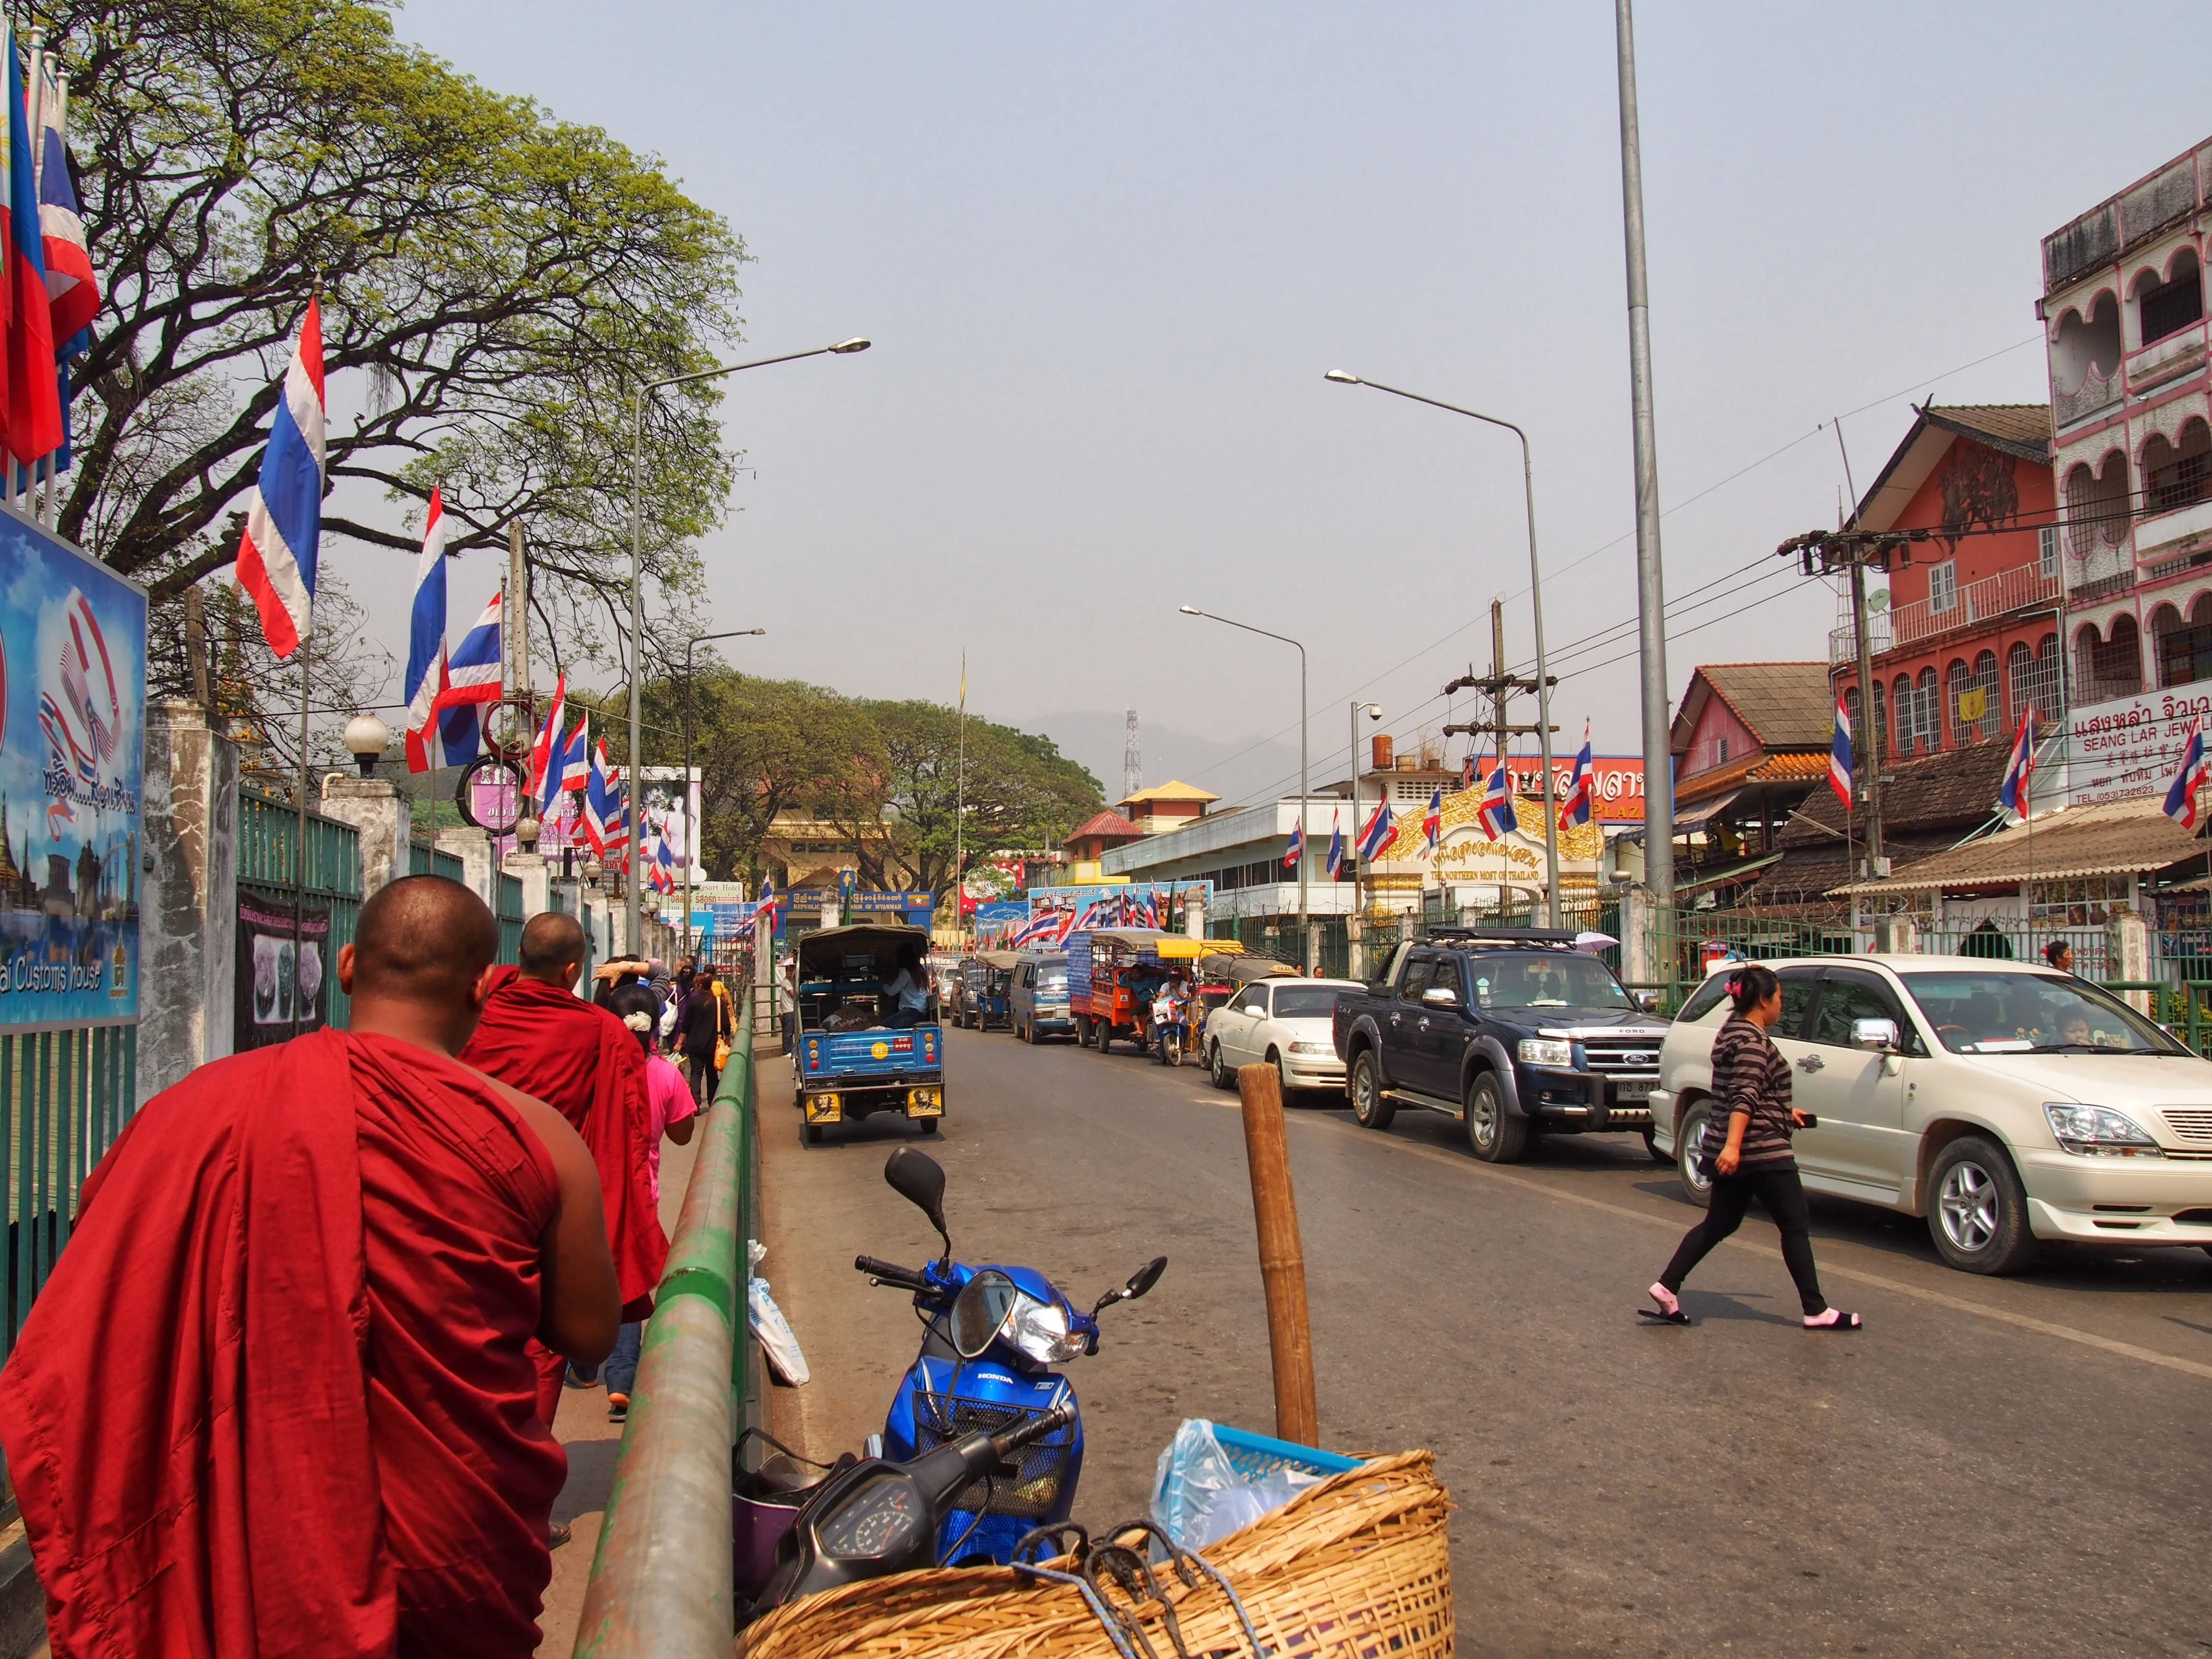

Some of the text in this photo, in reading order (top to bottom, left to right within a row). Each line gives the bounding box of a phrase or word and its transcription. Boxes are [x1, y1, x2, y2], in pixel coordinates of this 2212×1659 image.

[2075, 696, 2212, 738] แสงหล้า จิวเว
[2084, 733, 2126, 752] SEANG
[2131, 727, 2157, 744] LAR
[1431, 871, 1443, 880] THE
[1445, 871, 1478, 880] NORTHERN
[1480, 871, 1497, 880] MOST
[1509, 871, 1539, 880] THAILAND
[16, 955, 67, 993] Customs
[71, 955, 101, 991] house
[977, 1373, 1013, 1384] HONDA
